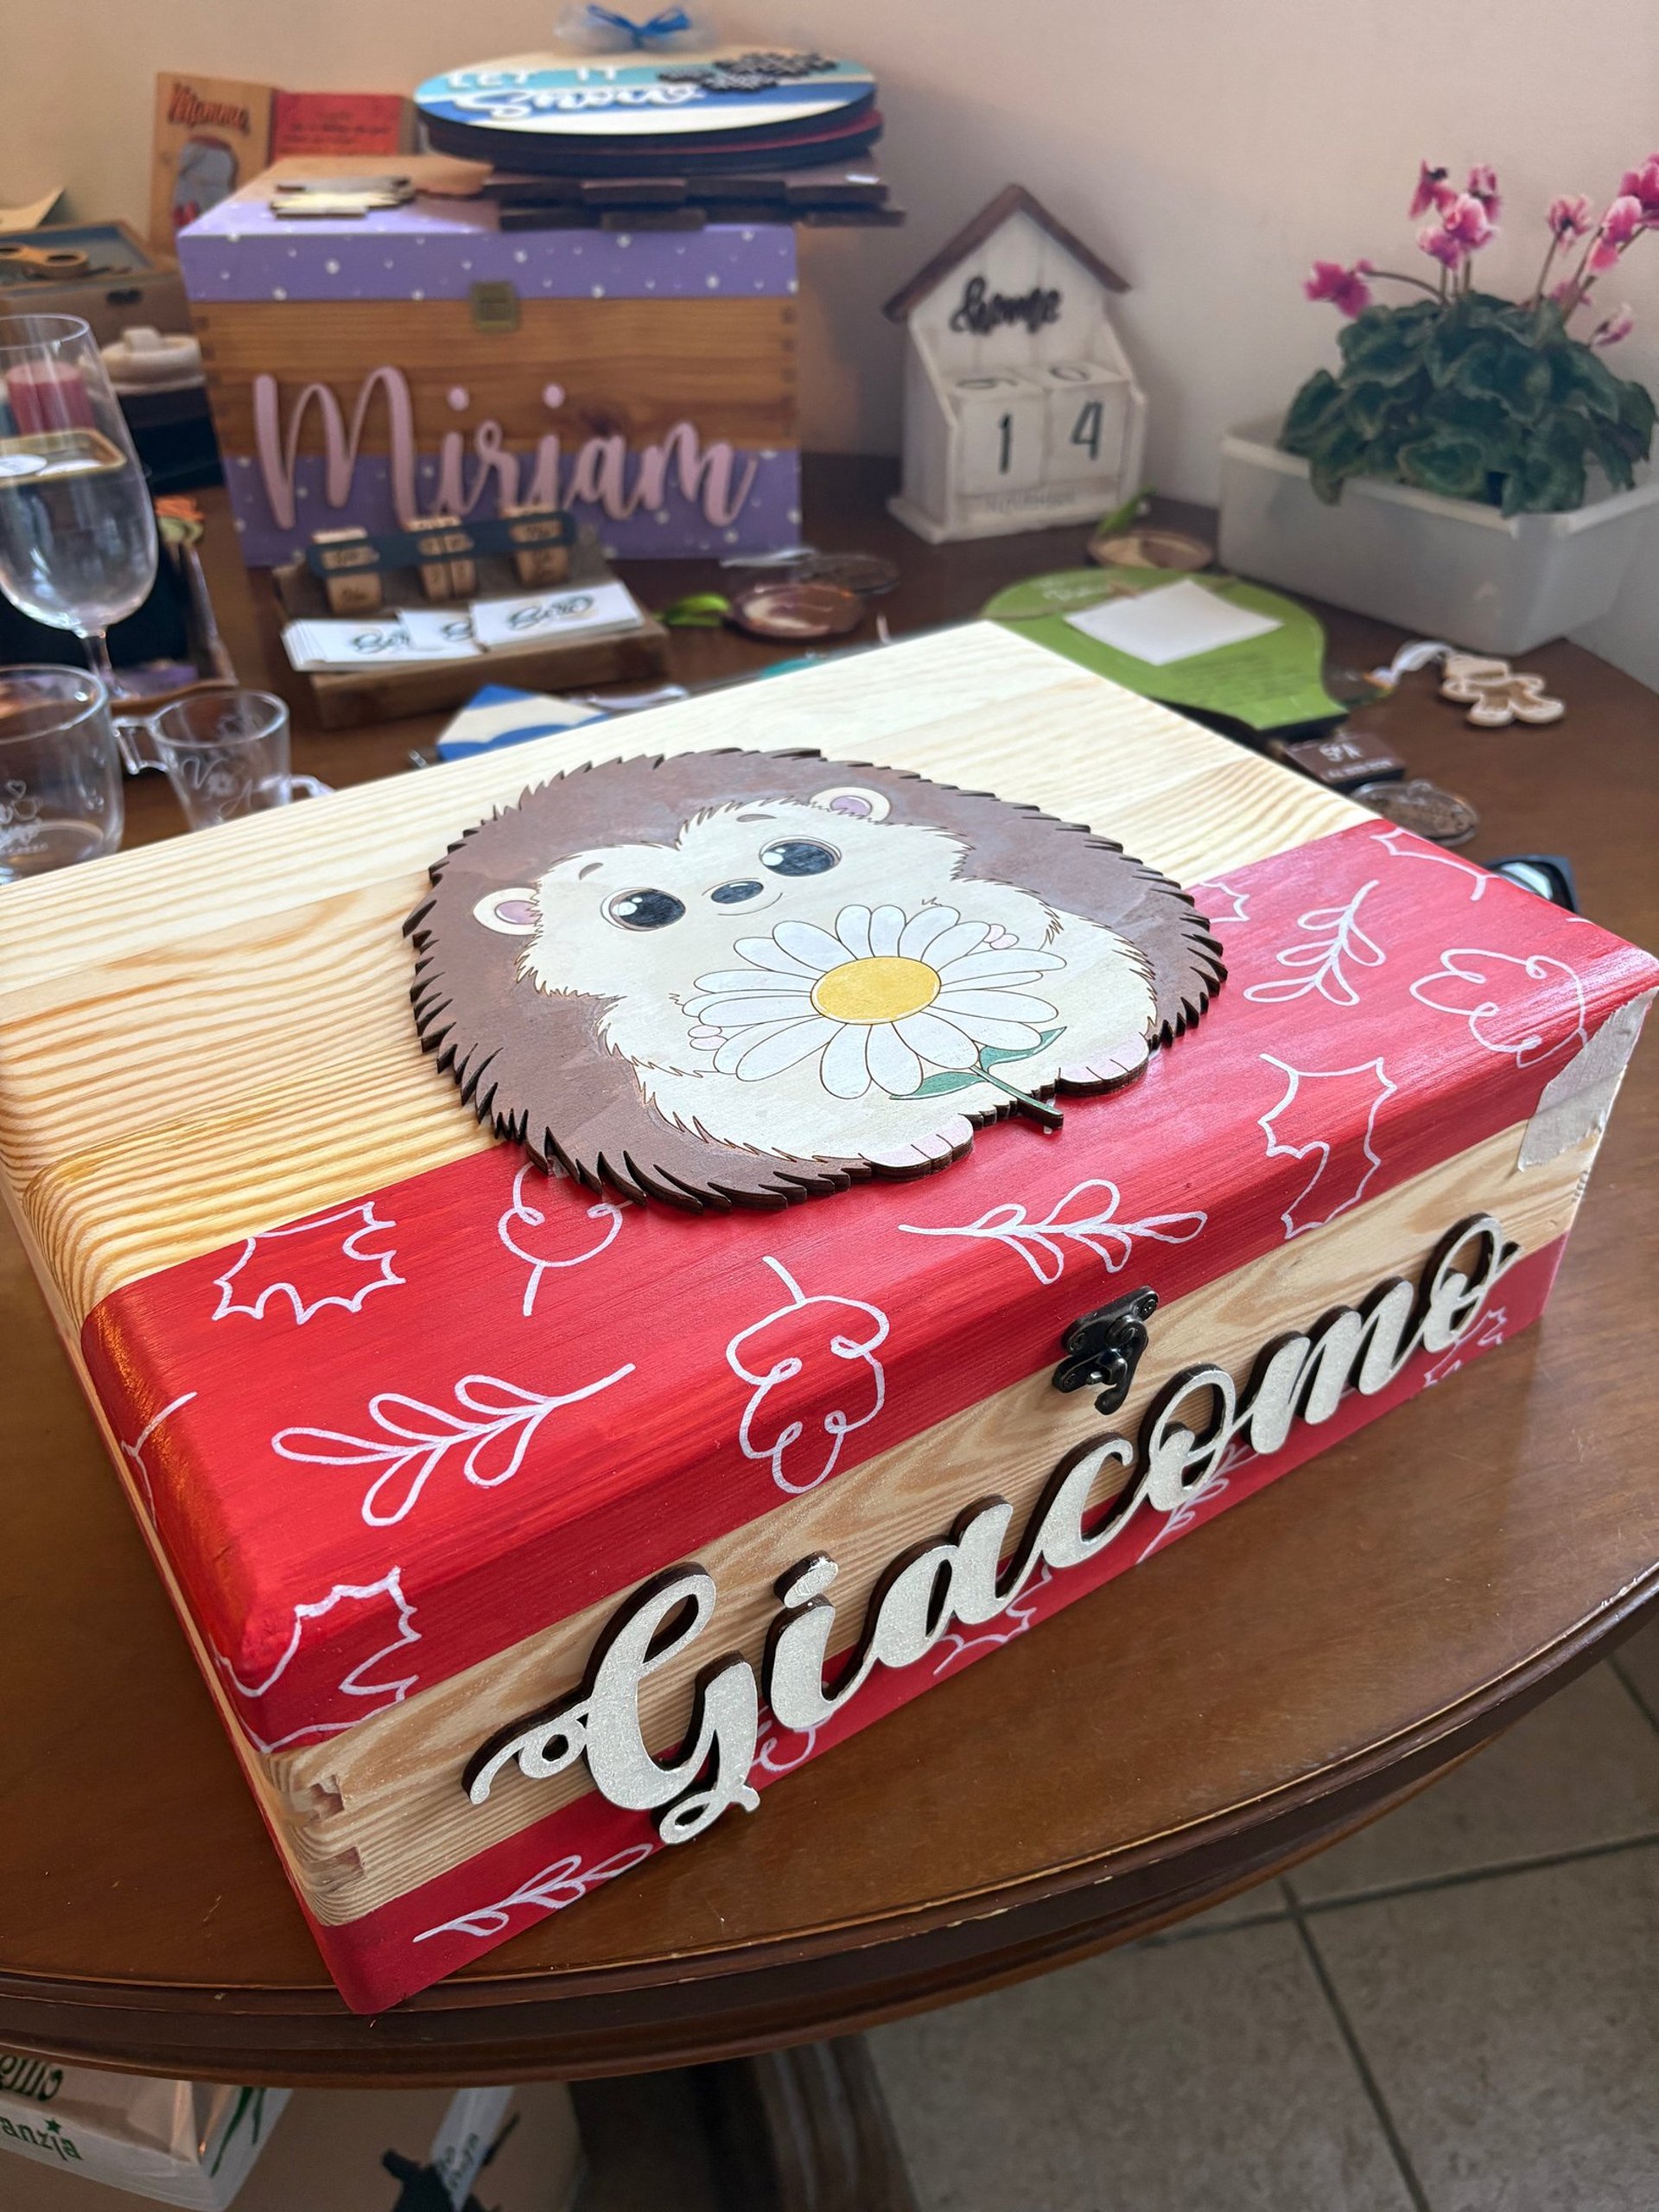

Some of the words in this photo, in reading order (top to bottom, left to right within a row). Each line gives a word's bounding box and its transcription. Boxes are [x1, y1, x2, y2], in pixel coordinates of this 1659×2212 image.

[447, 69, 532, 89] LET
[574, 66, 619, 83] IT
[252, 365, 759, 531] Miriam
[999, 410, 1014, 475] 1
[1070, 400, 1104, 461] 4
[461, 1212, 1523, 1846] Giacomo
